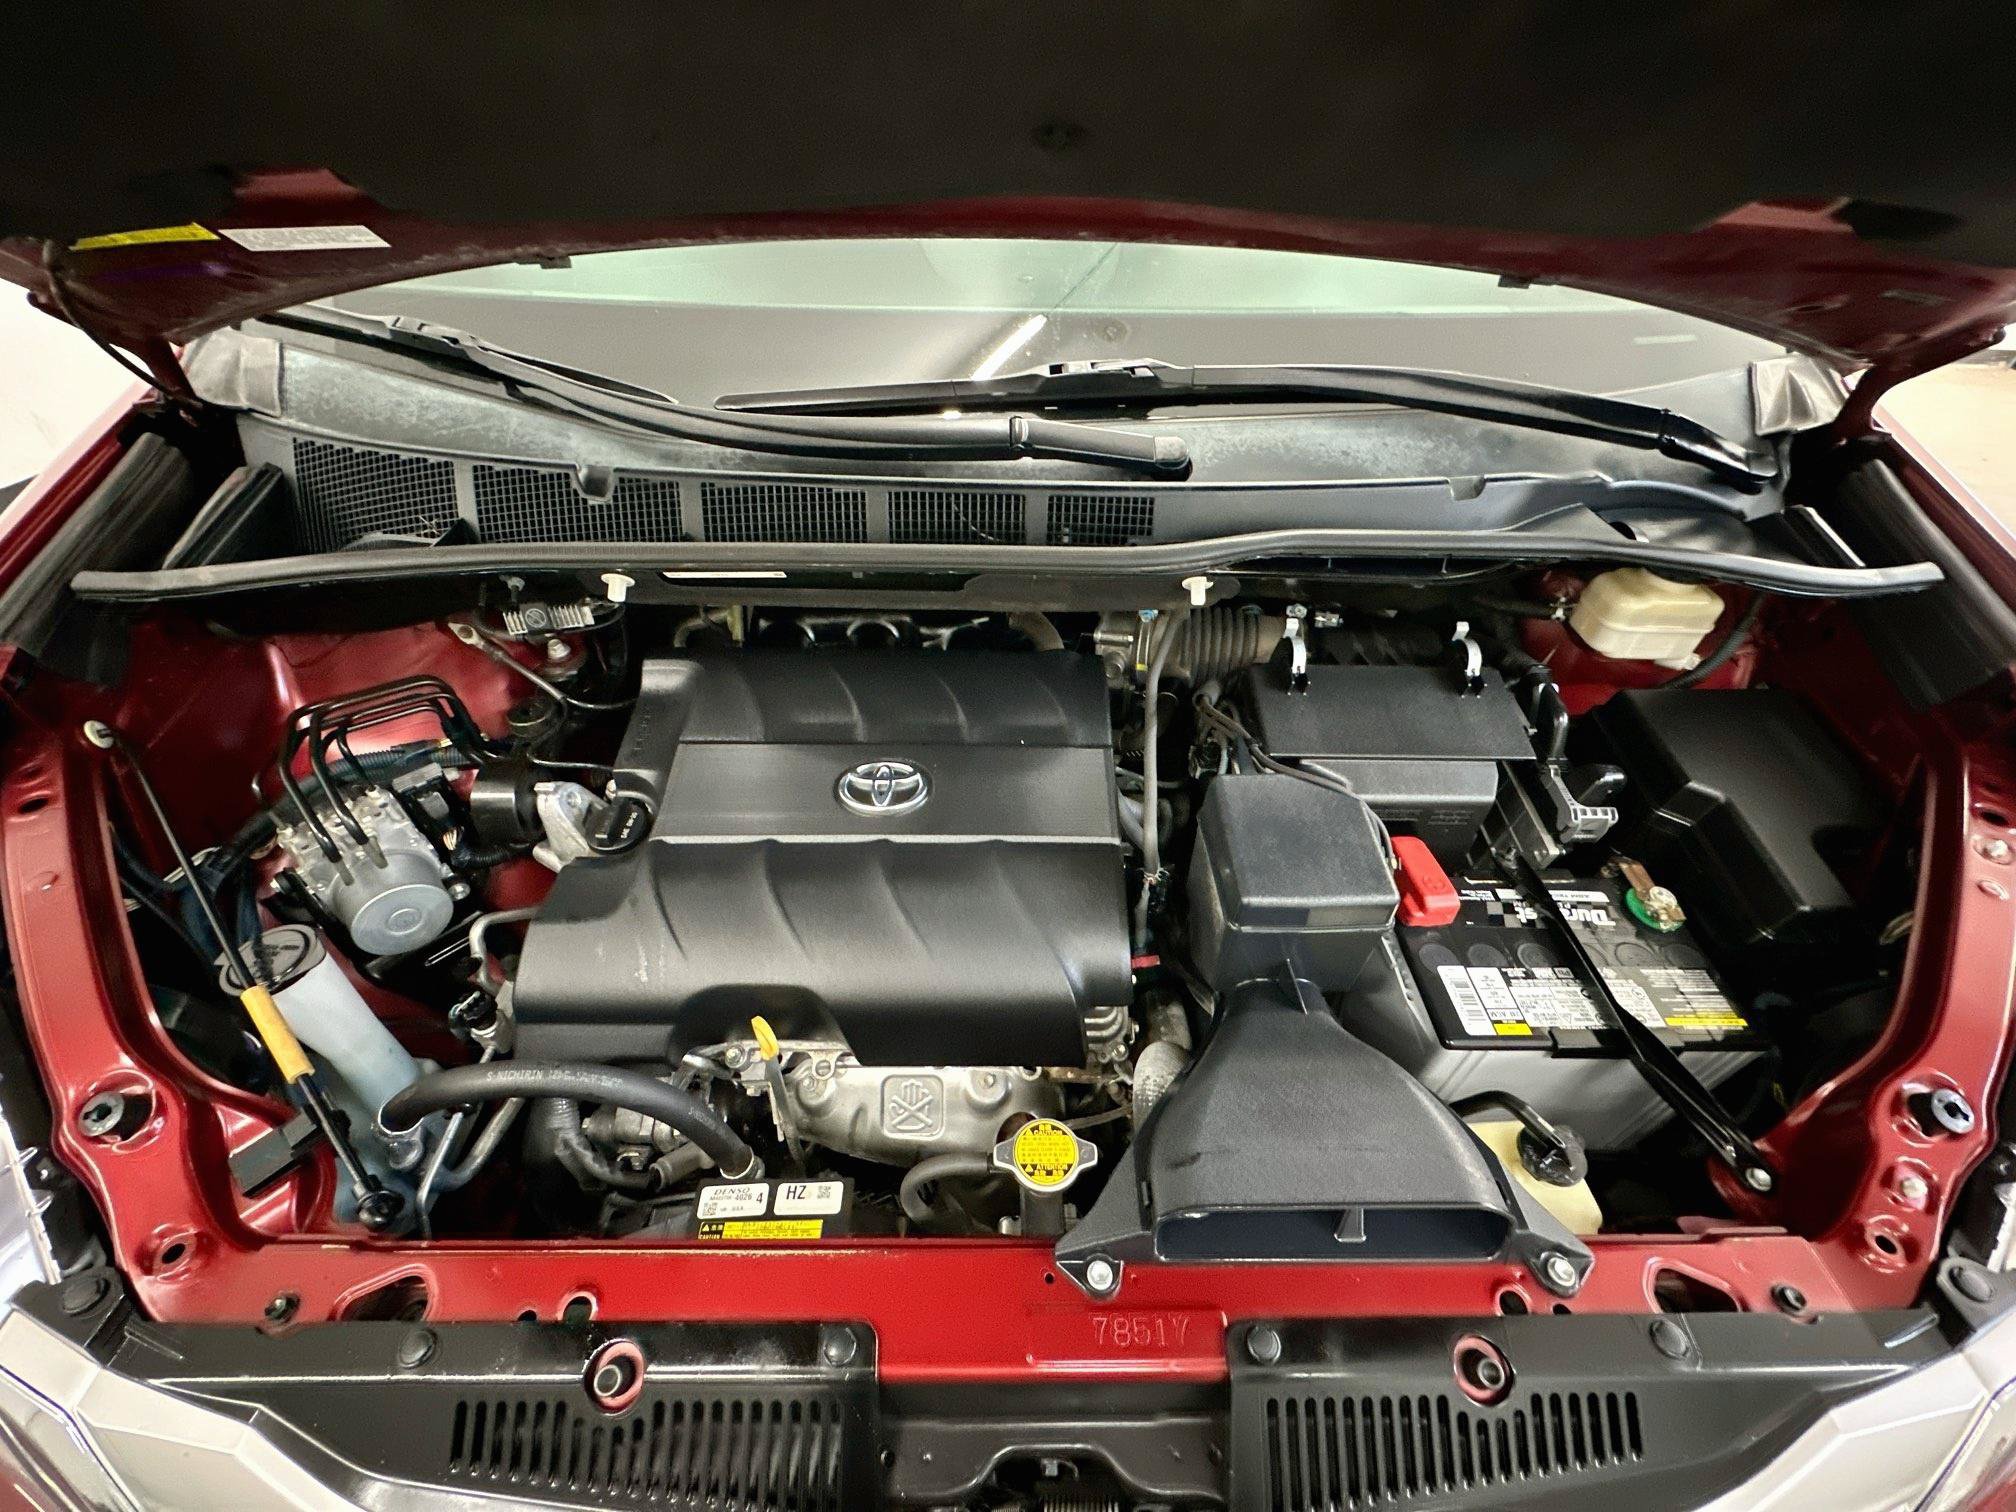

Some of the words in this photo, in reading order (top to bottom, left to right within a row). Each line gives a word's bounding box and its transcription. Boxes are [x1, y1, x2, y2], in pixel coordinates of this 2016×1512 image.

[1513, 905, 1617, 926] Durst
[1037, 1163, 1068, 1171] ATTENTION
[714, 1187, 750, 1195] DENSO
[786, 1185, 807, 1200] HZ
[756, 1192, 763, 1204] 4
[1089, 1312, 1190, 1347] 78517
